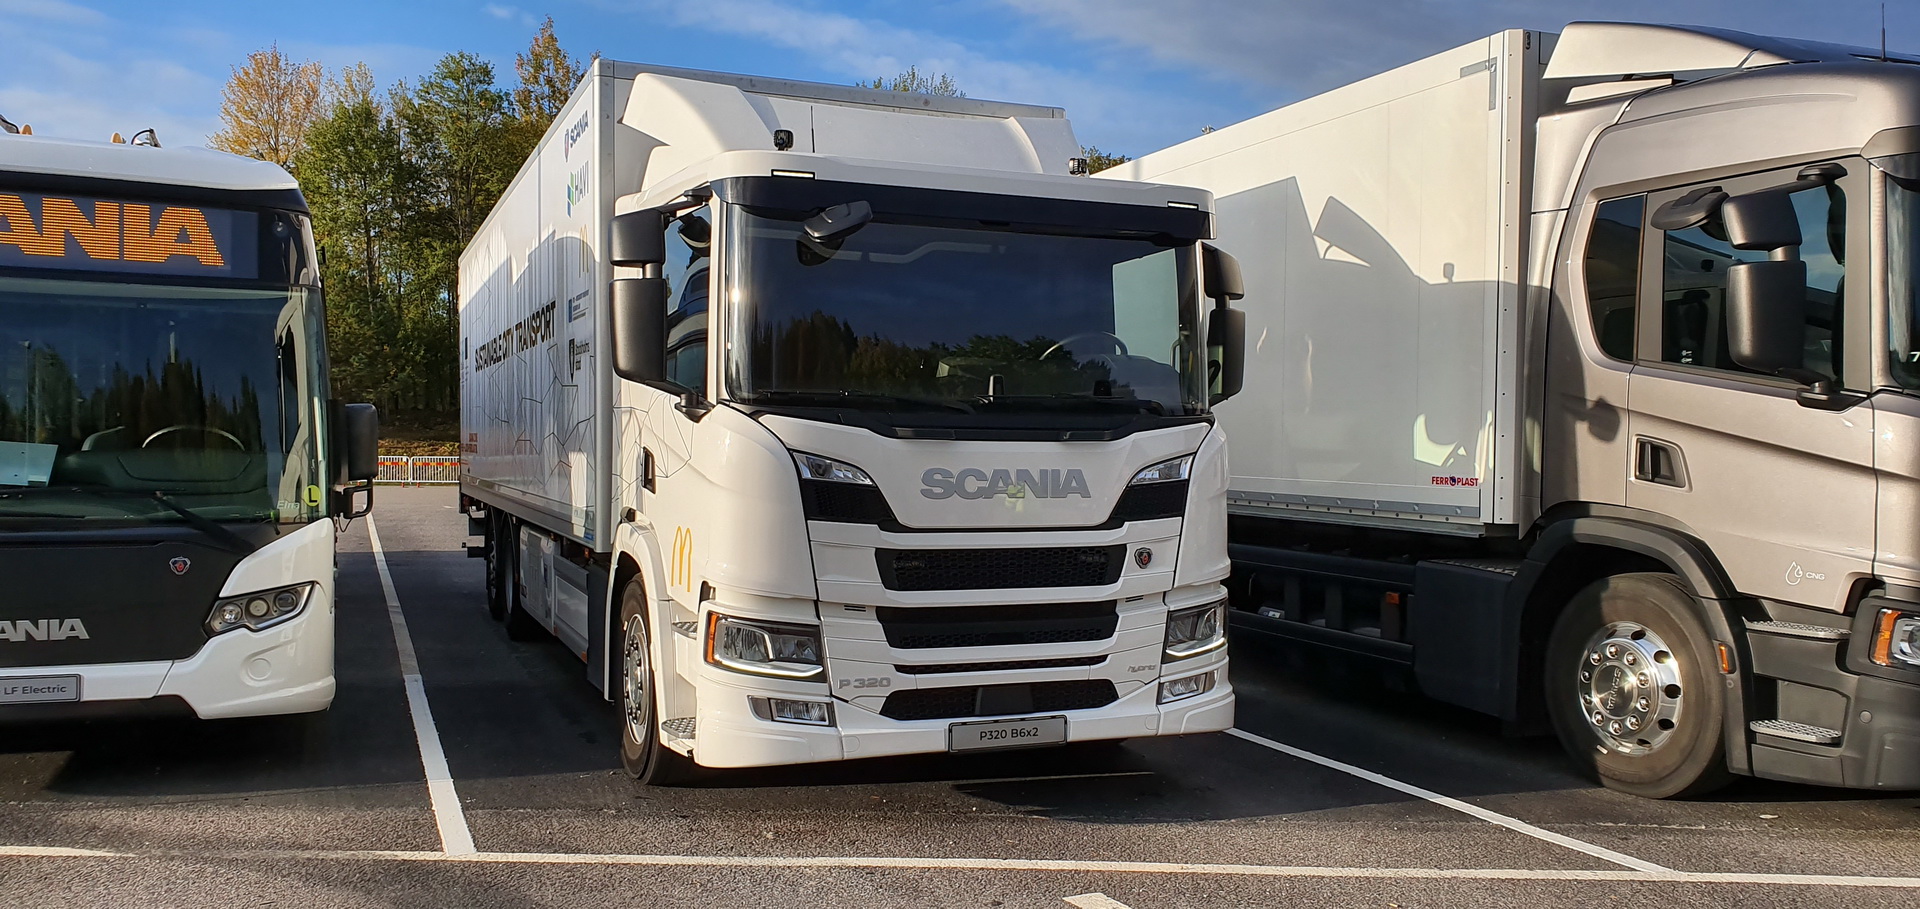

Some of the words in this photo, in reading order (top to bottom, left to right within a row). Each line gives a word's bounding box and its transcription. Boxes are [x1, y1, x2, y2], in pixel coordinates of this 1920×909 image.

[570, 109, 589, 149] SCANIA
[574, 160, 589, 205] HAVI
[475, 333, 502, 373] SUSTAINABLE
[502, 325, 514, 361] CITY
[514, 300, 556, 353] TRANSPORT
[920, 467, 1091, 500] SCANIA
[1431, 475, 1479, 487] FERROPLAST
[1805, 571, 1825, 581] CNG
[3, 686, 19, 696] LF
[21, 684, 68, 695] Electric
[837, 678, 851, 690] P
[852, 676, 892, 689] 320
[979, 729, 1008, 741] P320
[1010, 727, 1039, 739] B6x2
